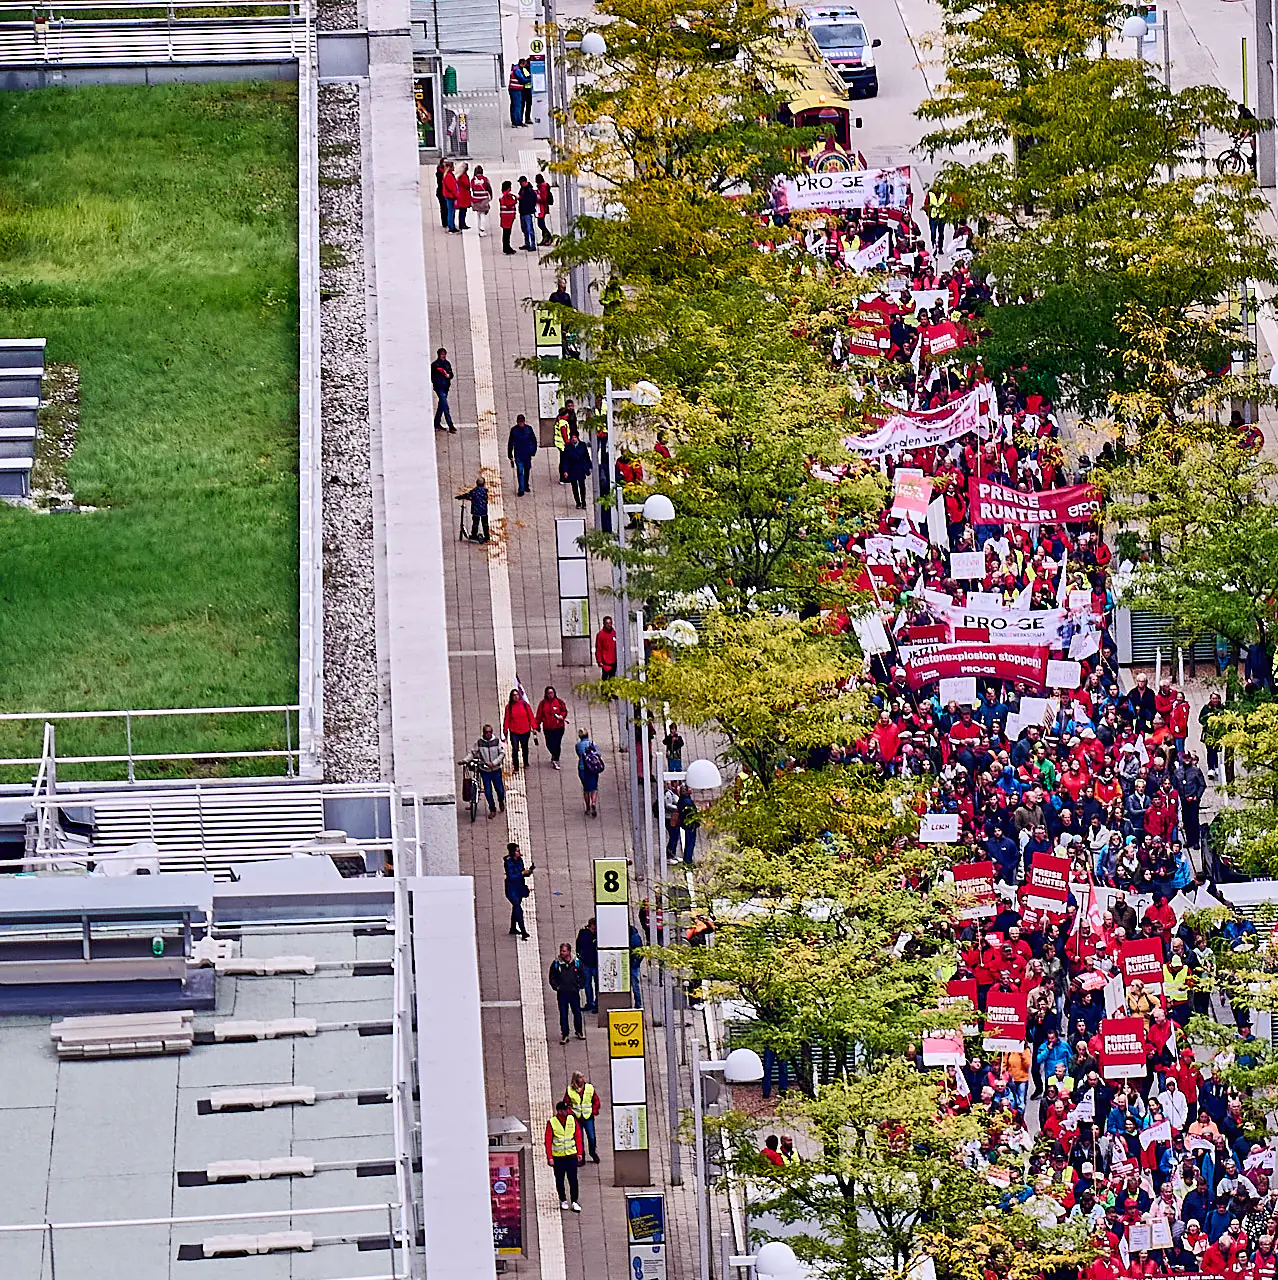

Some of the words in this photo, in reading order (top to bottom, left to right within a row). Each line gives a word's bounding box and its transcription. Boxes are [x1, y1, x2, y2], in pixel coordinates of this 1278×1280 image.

[539, 317, 557, 338] 7A
[878, 437, 921, 454] werden
[924, 433, 943, 445] wir
[979, 483, 1039, 508] PREISE
[980, 502, 1057, 521] RUNTER!
[964, 615, 1044, 630] PRO-GE
[910, 651, 996, 668] Kostenexplosion
[999, 653, 1042, 669] stoppen!
[961, 665, 995, 674] PRO-GE
[603, 870, 619, 892] 8
[1033, 867, 1062, 881] PREISE
[1033, 875, 1066, 888] RUNTER
[1125, 954, 1154, 967] PREISE
[1125, 961, 1161, 975] RUNTER
[988, 1005, 1015, 1017] PREISE
[988, 1012, 1019, 1023] RUNTER
[628, 1039, 639, 1048] 99
[1105, 1034, 1136, 1045] PREISE
[1105, 1041, 1141, 1053] RUNTER
